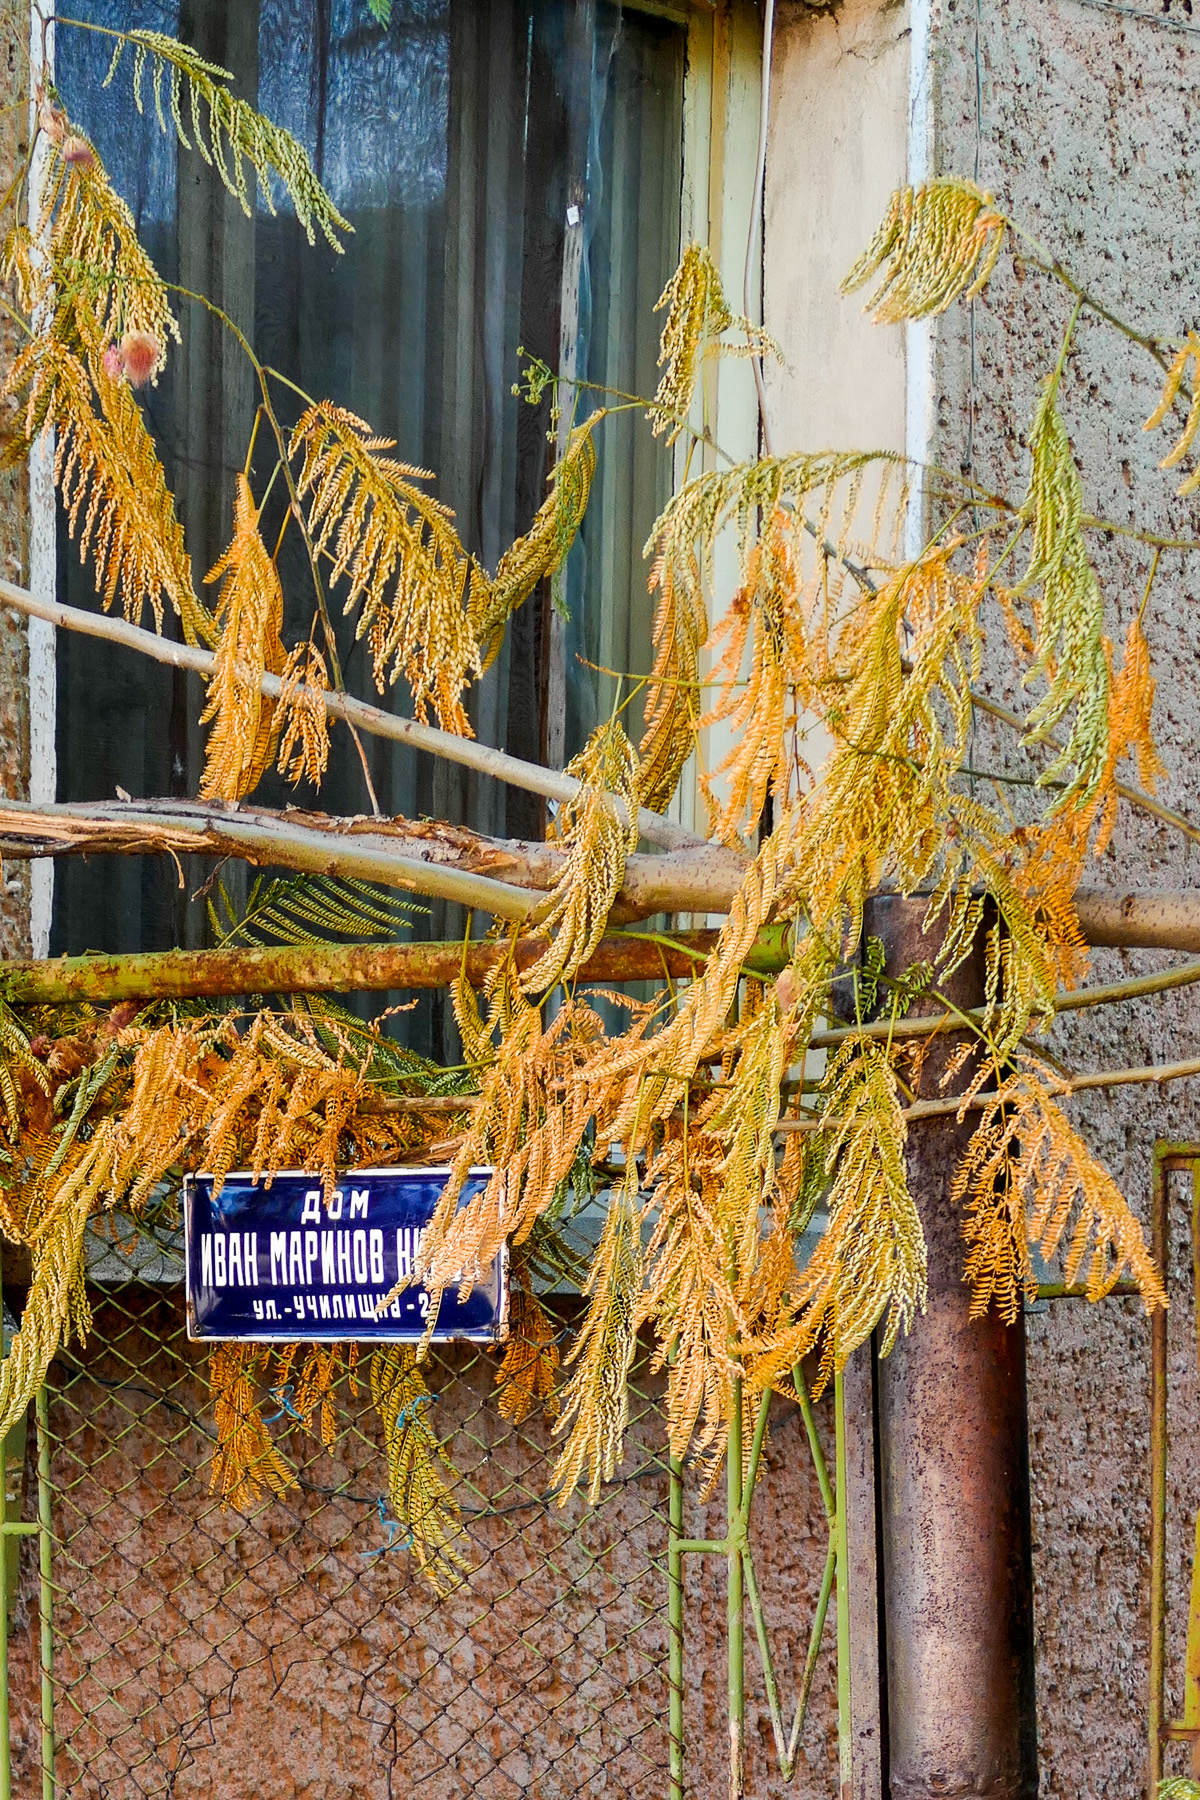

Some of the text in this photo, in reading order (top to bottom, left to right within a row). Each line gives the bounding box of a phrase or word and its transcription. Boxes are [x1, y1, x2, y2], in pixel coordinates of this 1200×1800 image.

[301, 1190, 369, 1225] ДОМ
[201, 1232, 259, 1287] ИВАН
[270, 1229, 385, 1286] МАРИНОВ
